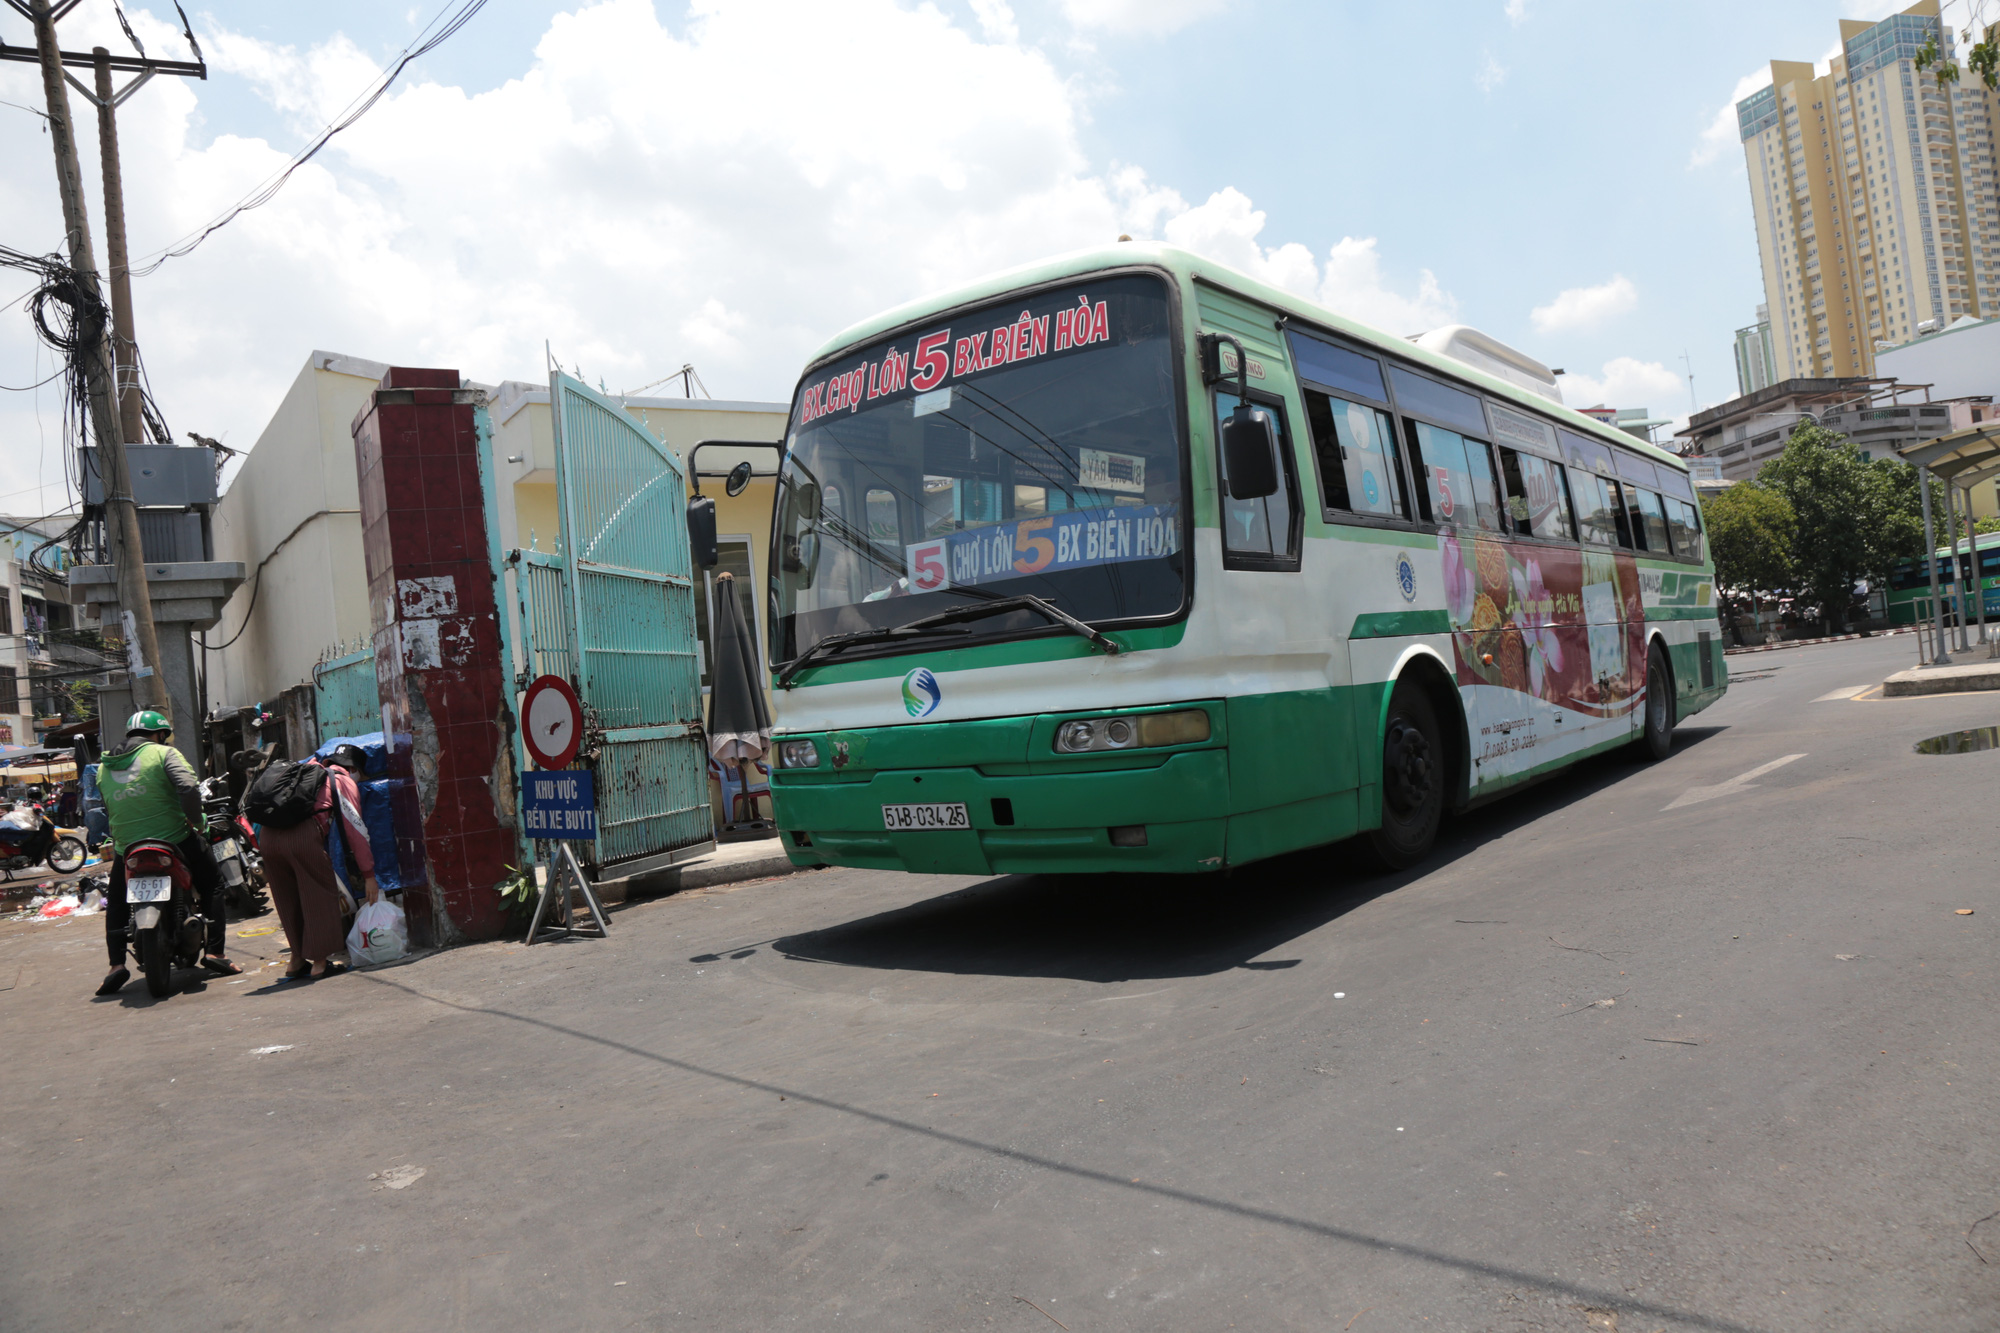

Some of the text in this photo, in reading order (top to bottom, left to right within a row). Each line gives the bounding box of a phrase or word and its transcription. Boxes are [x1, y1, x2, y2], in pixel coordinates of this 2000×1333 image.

[801, 295, 1109, 425] BX.CHỢ LỚN 5 BX.BIÊN HÒA
[1435, 466, 1454, 518] 5
[914, 546, 945, 589] 5
[952, 509, 1176, 585] CHỢ LỚN 5 BX BIÊN HÒA
[113, 783, 147, 800] Grab
[535, 777, 578, 804] KHU VỰC
[526, 803, 592, 830] BẾN XE BUÝT
